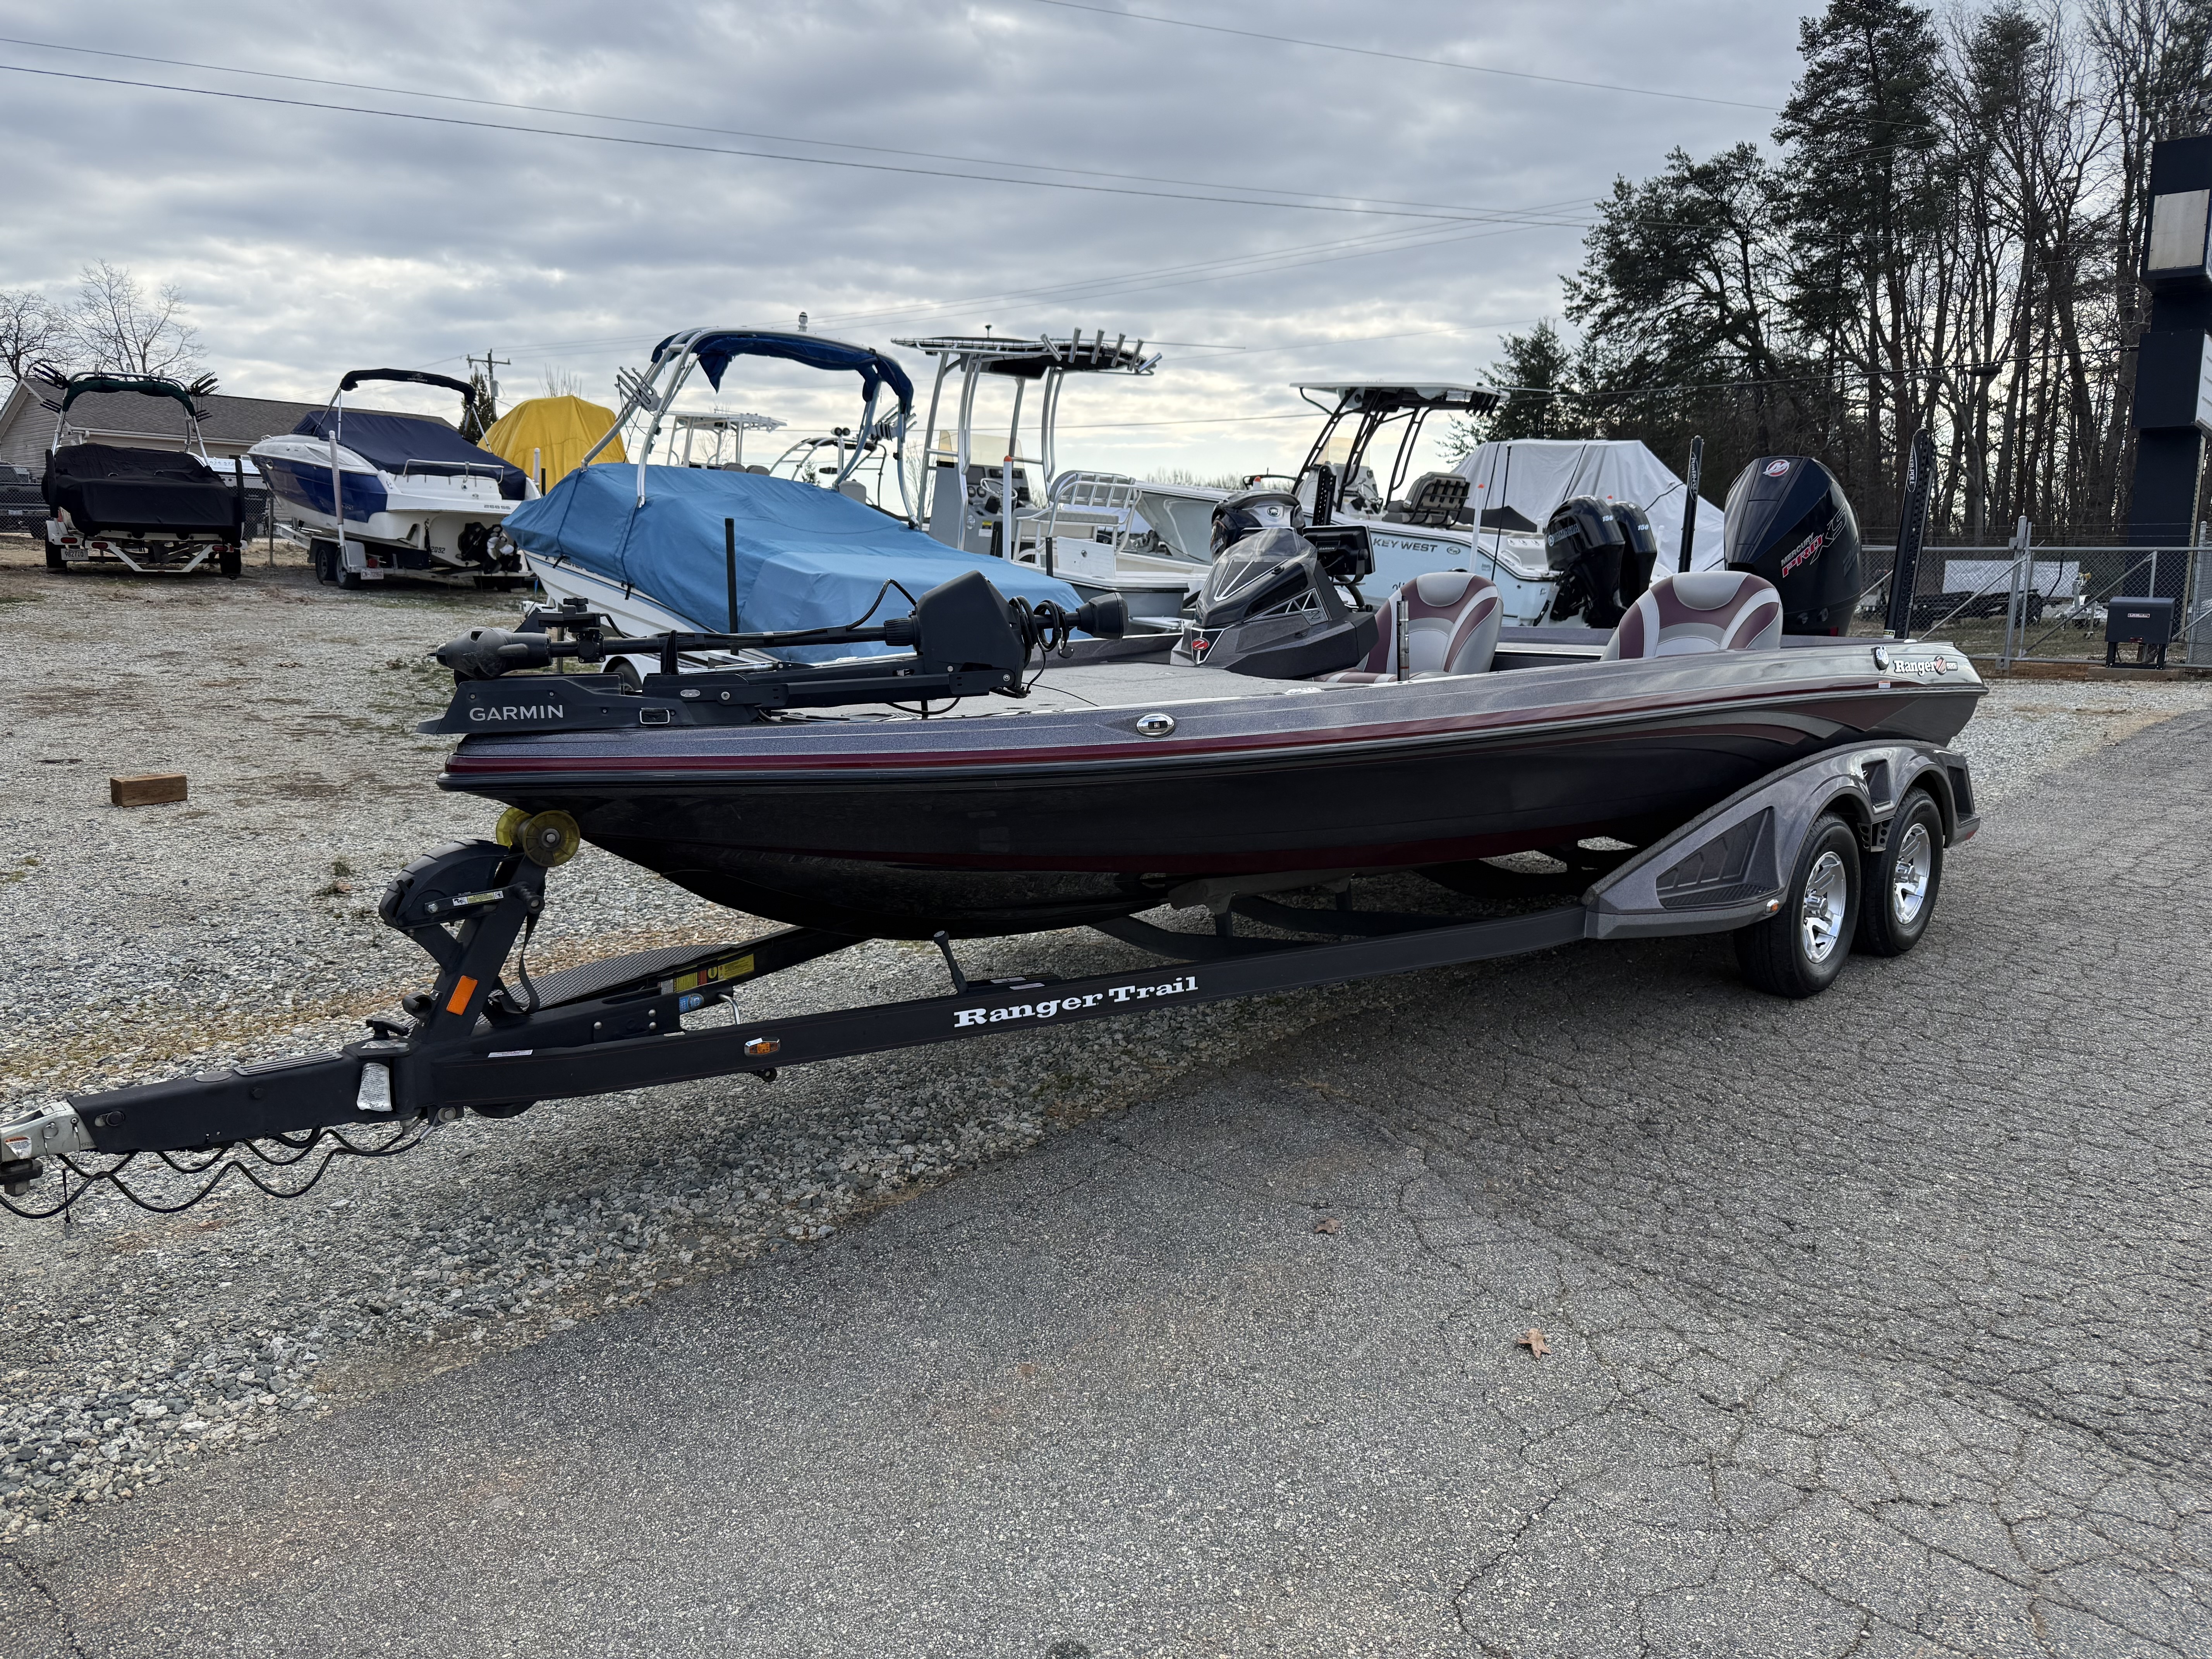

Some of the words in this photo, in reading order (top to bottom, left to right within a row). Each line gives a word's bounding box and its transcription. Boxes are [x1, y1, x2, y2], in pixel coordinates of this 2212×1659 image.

[1553, 523, 1580, 543] YAMAHA
[1373, 538, 1399, 548] KEY
[1401, 541, 1438, 553] WEST
[1781, 532, 1814, 567] MERCURY
[1782, 534, 1823, 578] PRO
[1893, 659, 1936, 677] Ranger
[469, 705, 563, 721] GARMIN
[954, 993, 1103, 1028] Ranger
[1108, 976, 1199, 1003] Trail
